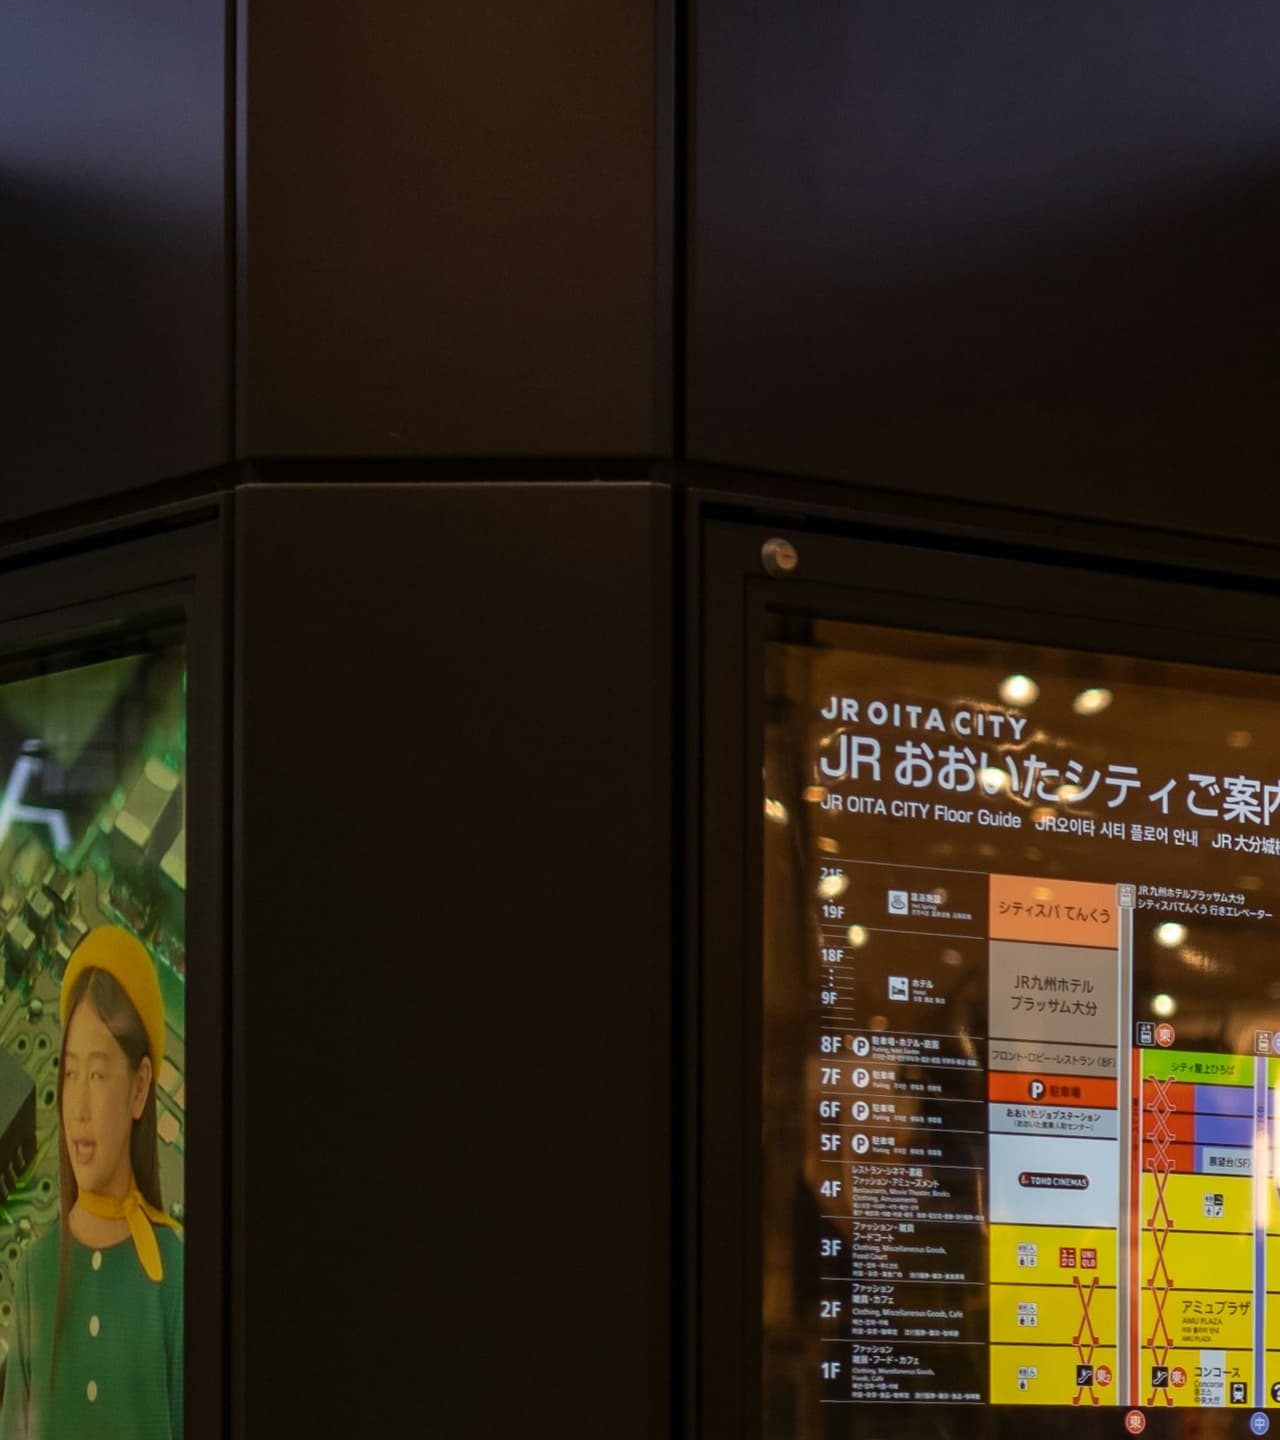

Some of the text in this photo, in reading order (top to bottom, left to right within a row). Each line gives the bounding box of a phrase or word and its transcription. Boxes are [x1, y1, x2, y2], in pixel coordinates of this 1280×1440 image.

[821, 696, 1029, 741] JR OITA CITY
[820, 734, 882, 782] JR
[820, 794, 1023, 829] JR OITA CITY Floor Guide
[1172, 828, 1199, 848] 안내
[1211, 833, 1233, 851] JR
[821, 905, 845, 920] 19F
[1065, 906, 1112, 924] てんくう
[821, 948, 844, 963] 18F
[1014, 974, 1095, 995] JR九州ホテル
[820, 991, 839, 1005] 9F
[1010, 995, 1098, 1017] ブラッサム大分
[820, 1035, 842, 1054] 8F
[820, 1067, 841, 1085] 7F
[819, 1100, 841, 1118] 6F
[820, 1134, 842, 1152] 5F
[820, 1180, 842, 1198] 4F
[820, 1239, 842, 1257] 3F
[820, 1300, 842, 1318] 2F
[1182, 1300, 1251, 1317] アミュプラザ
[821, 1362, 841, 1380] 1F
[1194, 1366, 1241, 1379] コンコース
